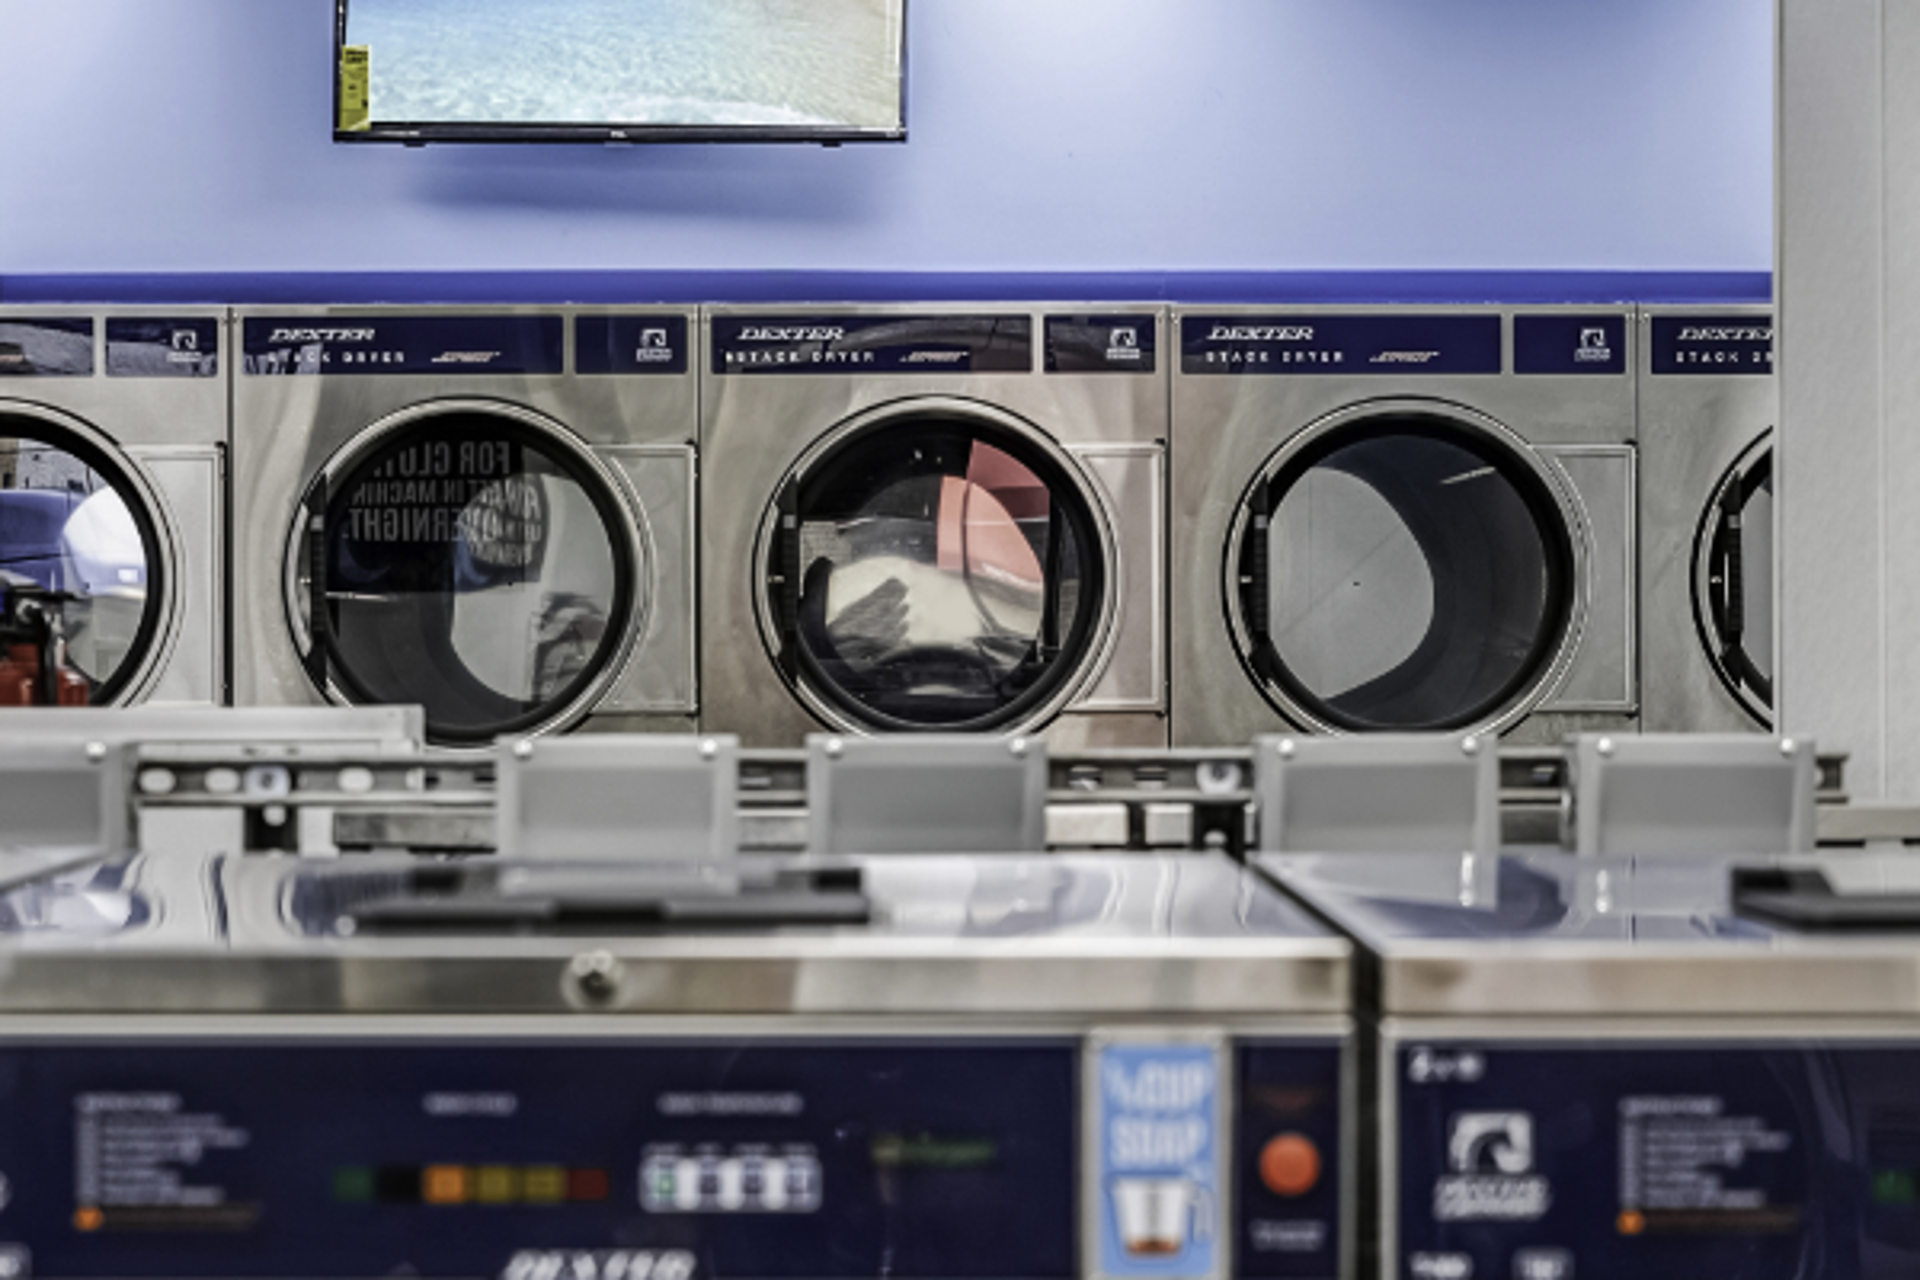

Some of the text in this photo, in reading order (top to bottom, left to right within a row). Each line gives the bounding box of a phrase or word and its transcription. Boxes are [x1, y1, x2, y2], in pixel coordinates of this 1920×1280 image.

[268, 328, 376, 342] DEXTER
[737, 326, 844, 340] DEXTER
[1206, 325, 1314, 340] DEXTER
[811, 351, 875, 362] DRYER
[1205, 351, 1268, 362] STACK
[1676, 351, 1739, 362] STACK
